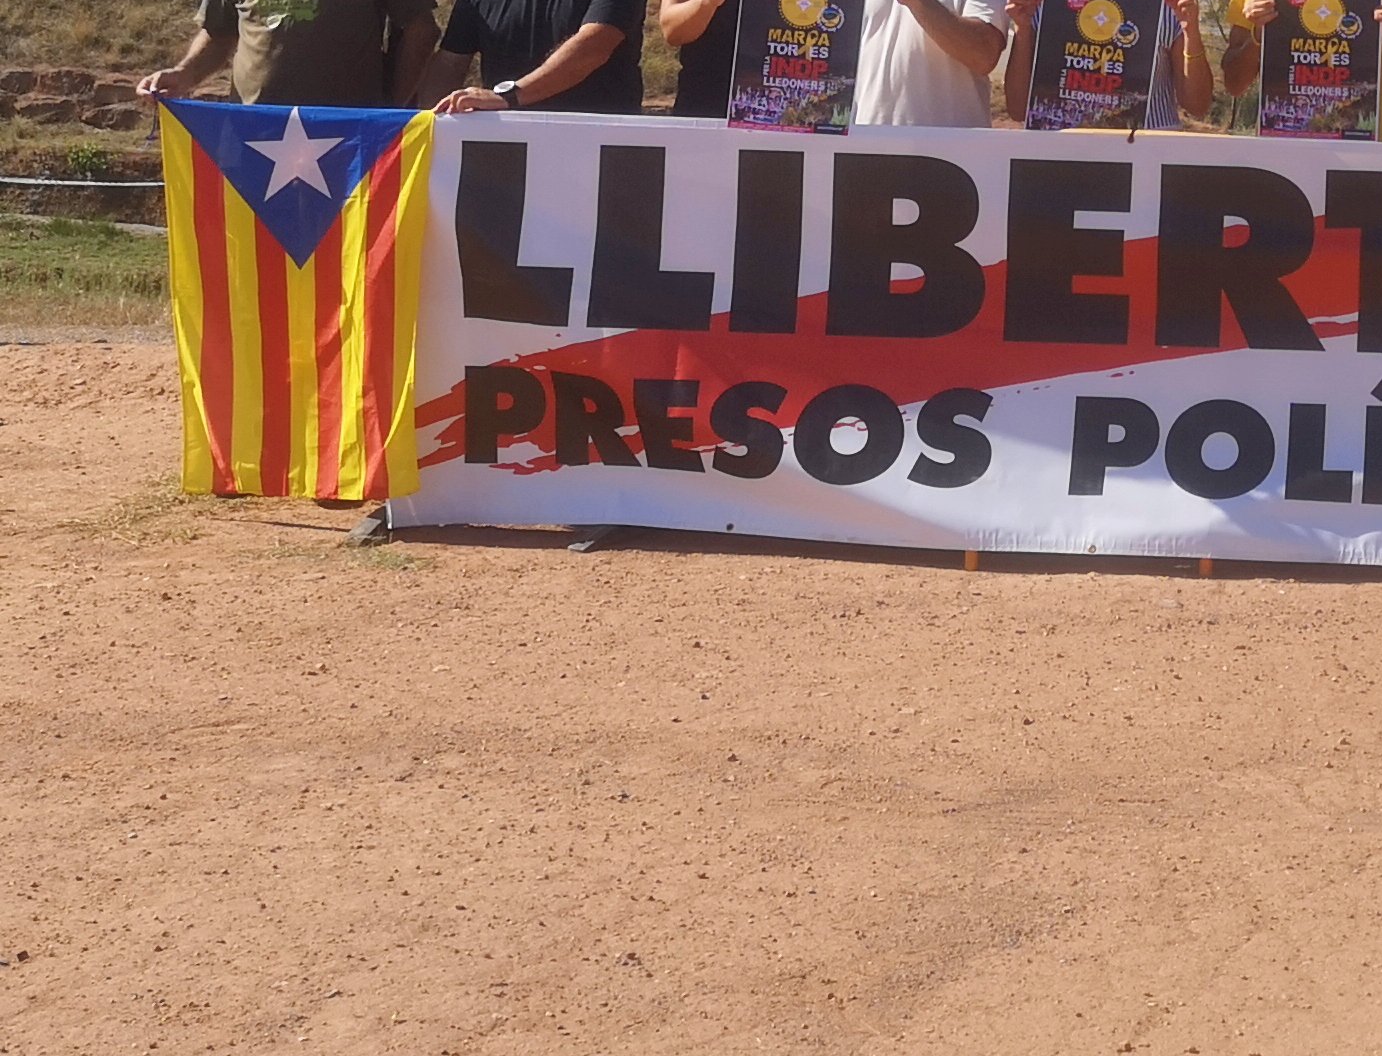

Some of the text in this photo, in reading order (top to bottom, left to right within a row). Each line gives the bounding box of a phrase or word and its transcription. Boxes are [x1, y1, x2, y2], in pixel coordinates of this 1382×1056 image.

[763, 76, 825, 91] LLEDONERS
[1290, 85, 1349, 96] LLEDONERS
[1059, 88, 1119, 105] LLEDONERS
[464, 365, 993, 489] PRESOS
